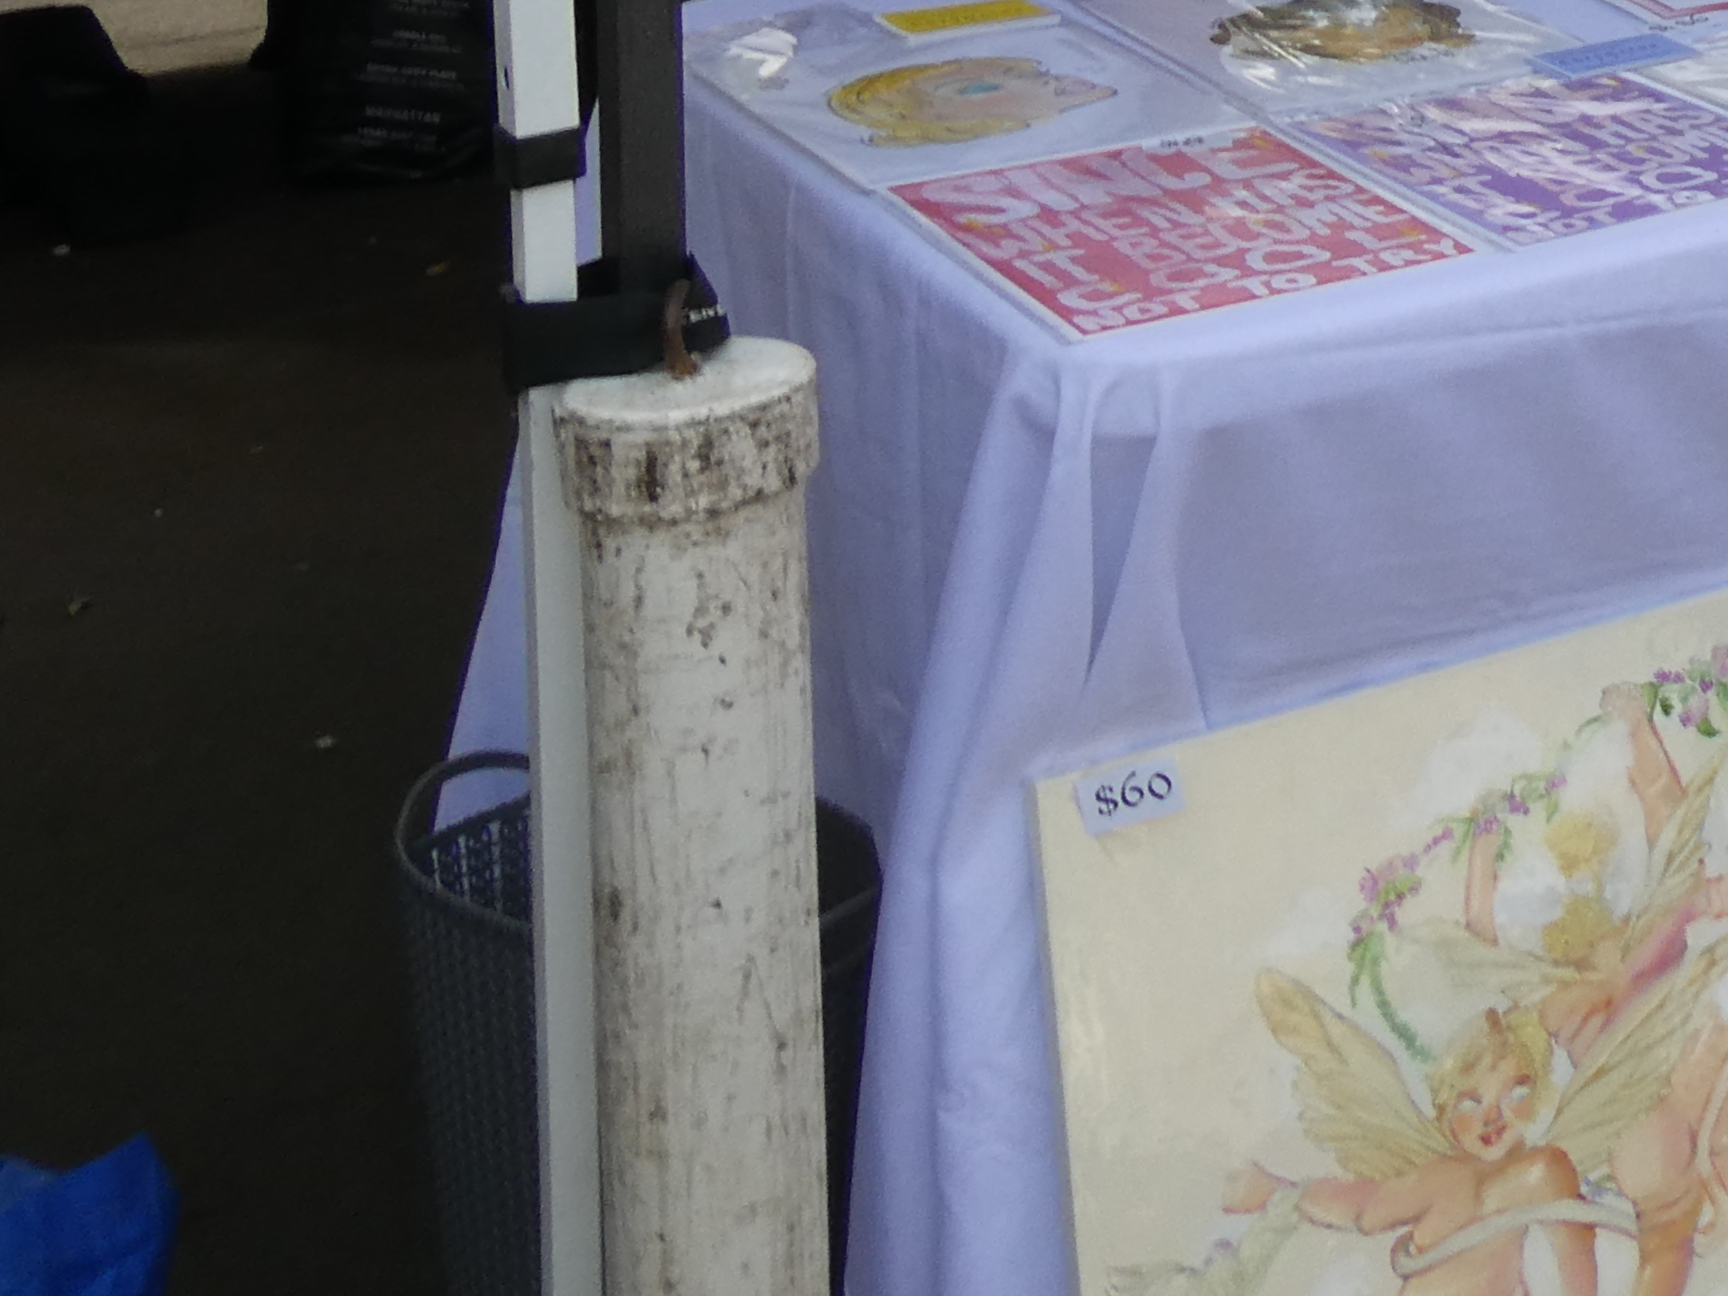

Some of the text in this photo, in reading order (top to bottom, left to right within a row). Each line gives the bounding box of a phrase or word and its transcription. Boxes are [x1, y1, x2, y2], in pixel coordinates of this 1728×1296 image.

[920, 131, 1298, 229] SINCE
[970, 201, 1204, 260] WHEN
[1012, 192, 1401, 288] IT BECOME
[1057, 228, 1442, 319] COOL
[1071, 237, 1462, 333] NOT TO TRY
[1094, 770, 1173, 818] $60
